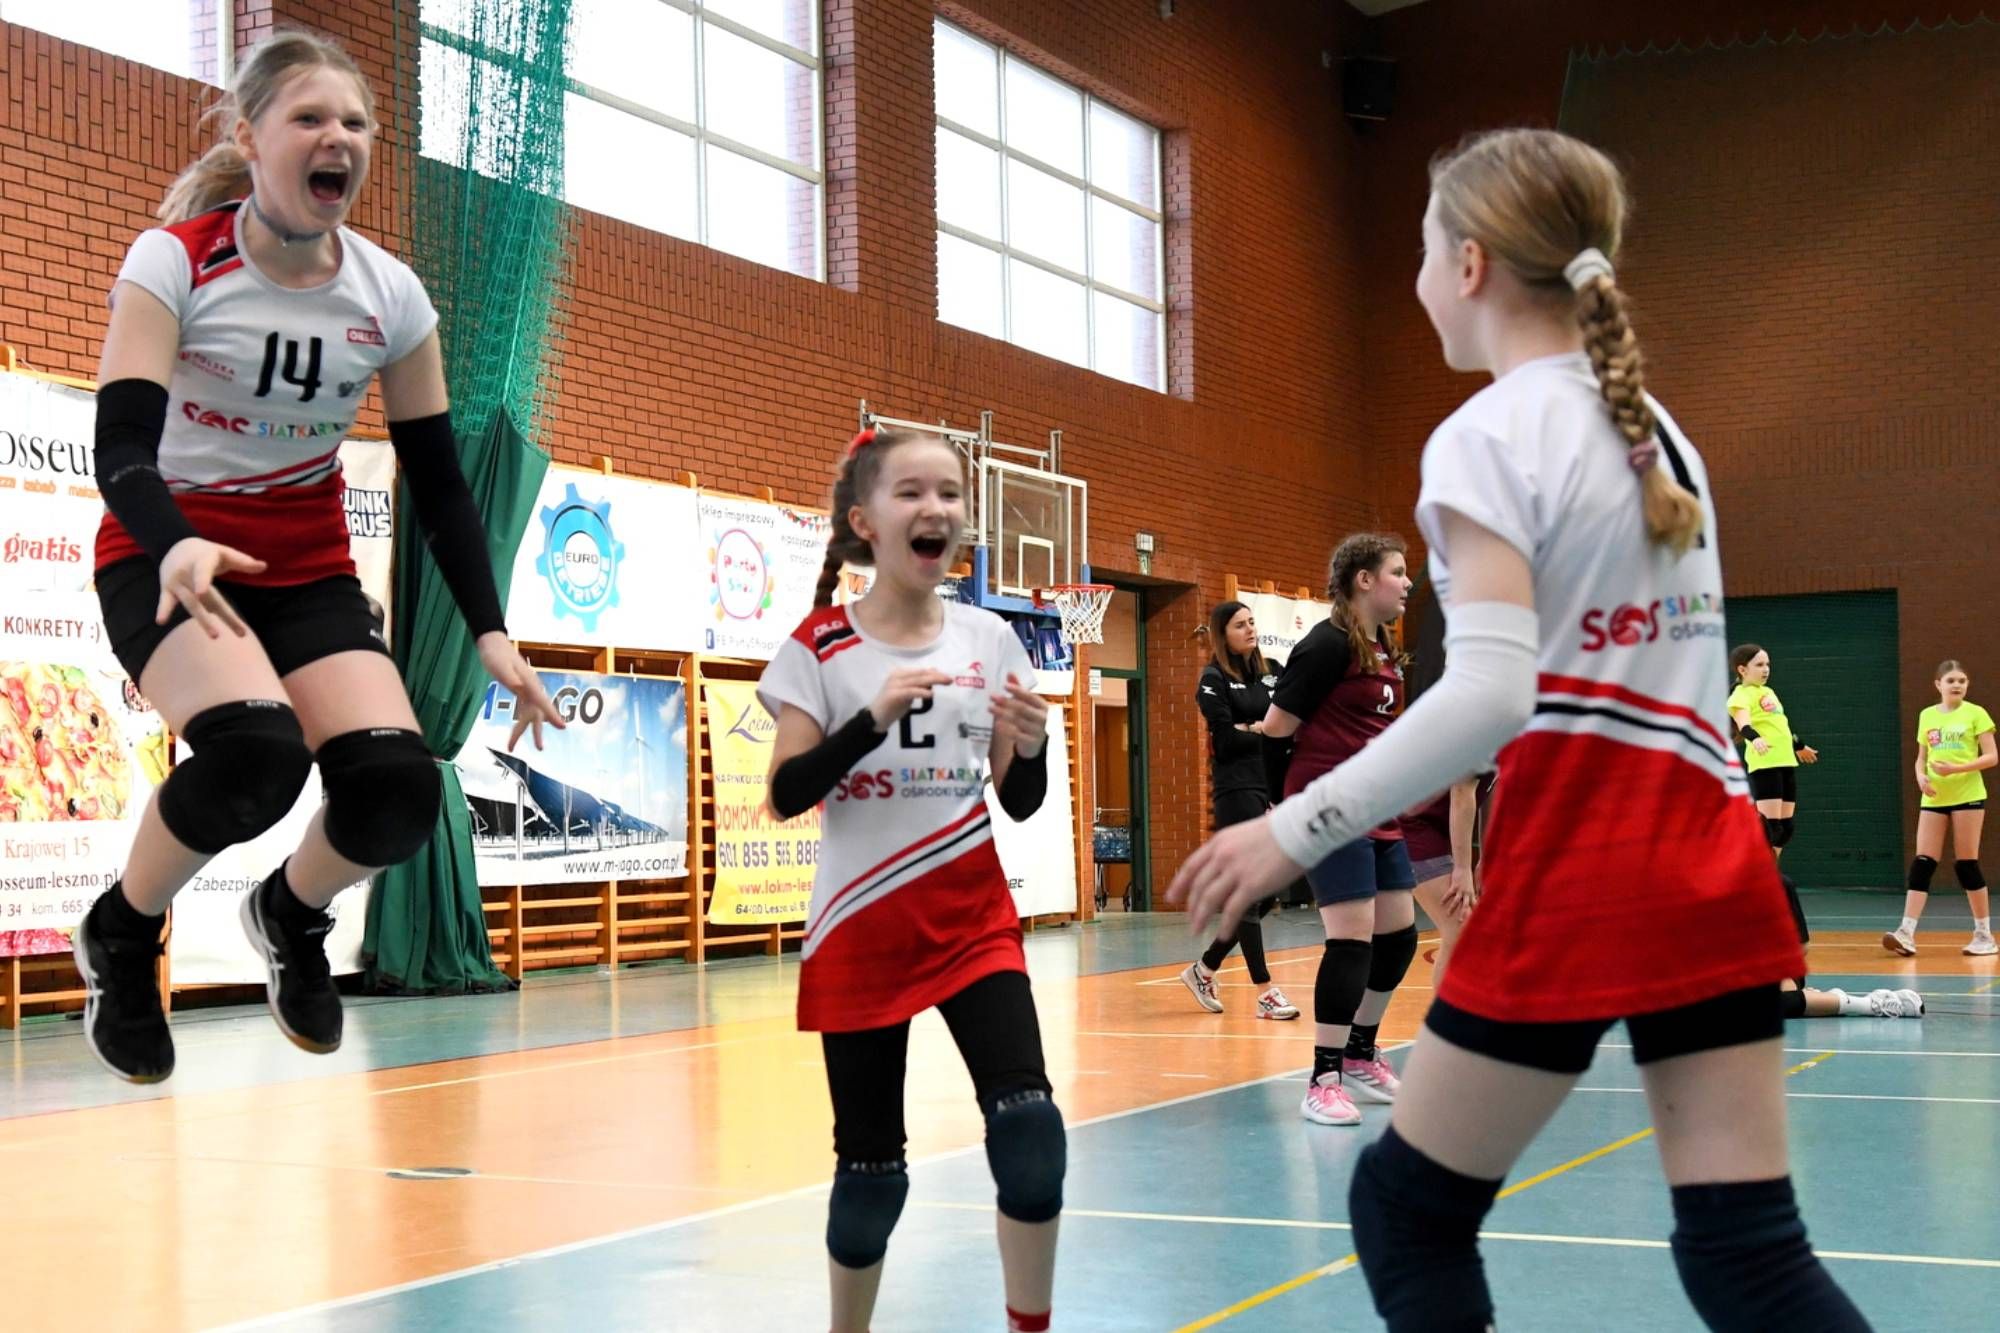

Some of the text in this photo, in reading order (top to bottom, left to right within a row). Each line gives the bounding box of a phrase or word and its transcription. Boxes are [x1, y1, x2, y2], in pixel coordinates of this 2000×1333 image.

[254, 331, 323, 401] 14
[0, 430, 97, 477] osseu
[4, 533, 82, 563] gratis
[565, 552, 599, 565] EURO
[4, 616, 84, 638] KONKRETY
[1376, 684, 1394, 714] 2
[900, 686, 935, 748] 2
[5, 836, 90, 861] Krajowej 15
[743, 841, 769, 868] 855
[61, 899, 83, 914] 665
